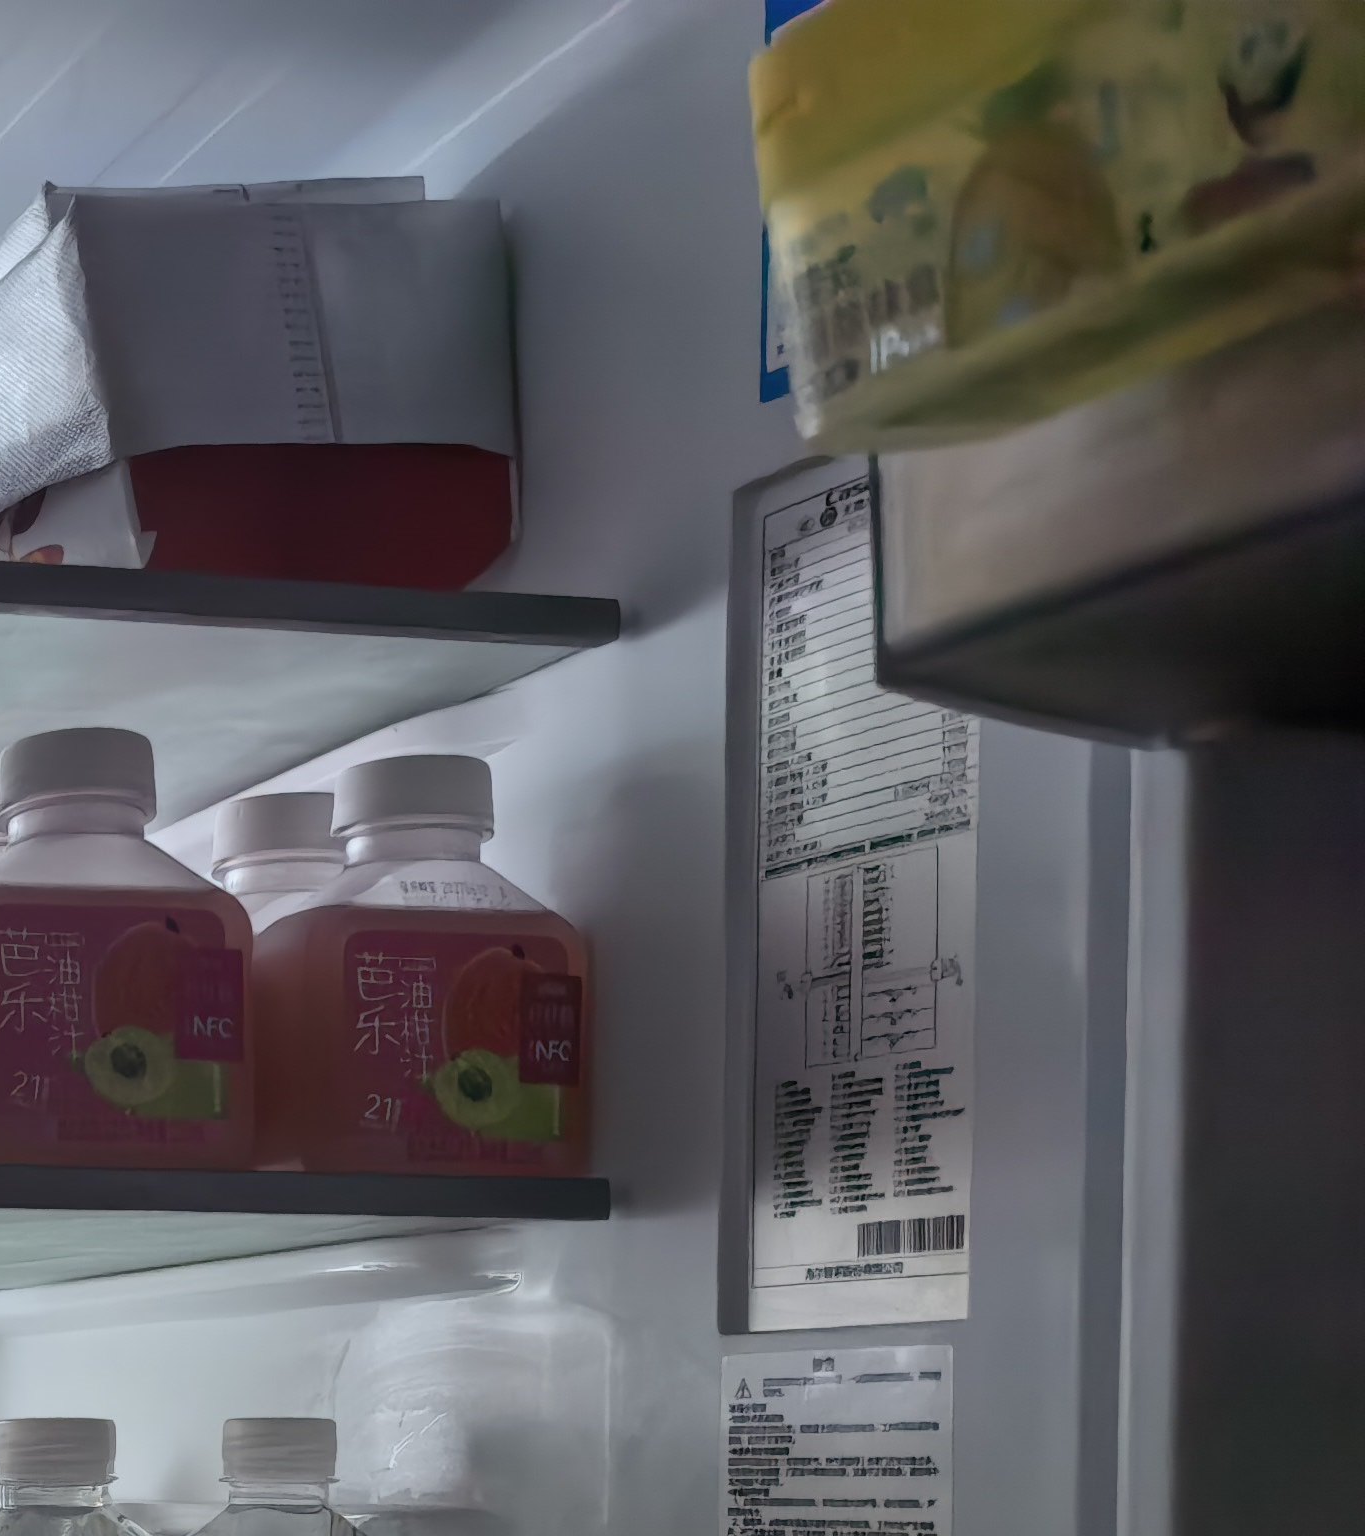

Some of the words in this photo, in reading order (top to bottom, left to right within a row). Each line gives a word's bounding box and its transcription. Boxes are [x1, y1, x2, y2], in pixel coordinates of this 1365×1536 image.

[354, 951, 405, 1055] 芭乐
[193, 1015, 233, 1040] NFC
[534, 1039, 572, 1062] NFC
